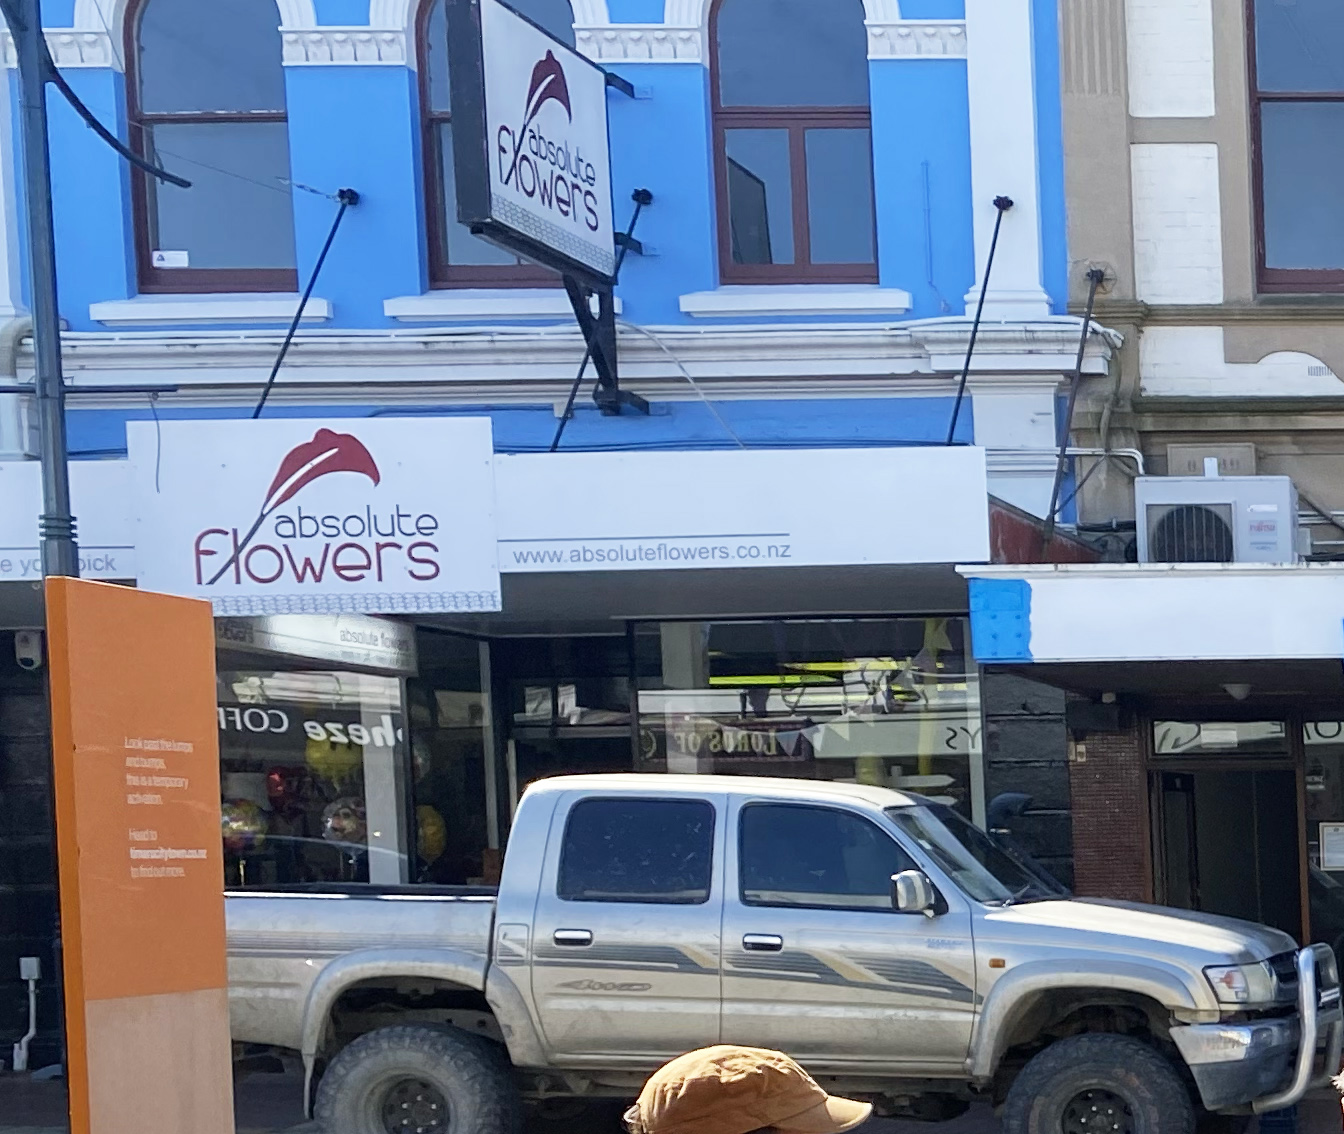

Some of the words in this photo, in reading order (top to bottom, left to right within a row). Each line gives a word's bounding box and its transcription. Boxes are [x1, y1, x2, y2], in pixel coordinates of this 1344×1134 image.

[528, 123, 596, 187] absolute
[275, 504, 440, 539] absolute
[194, 527, 441, 586] flowers
[513, 541, 792, 565] www.absoluteflowers.co.nz
